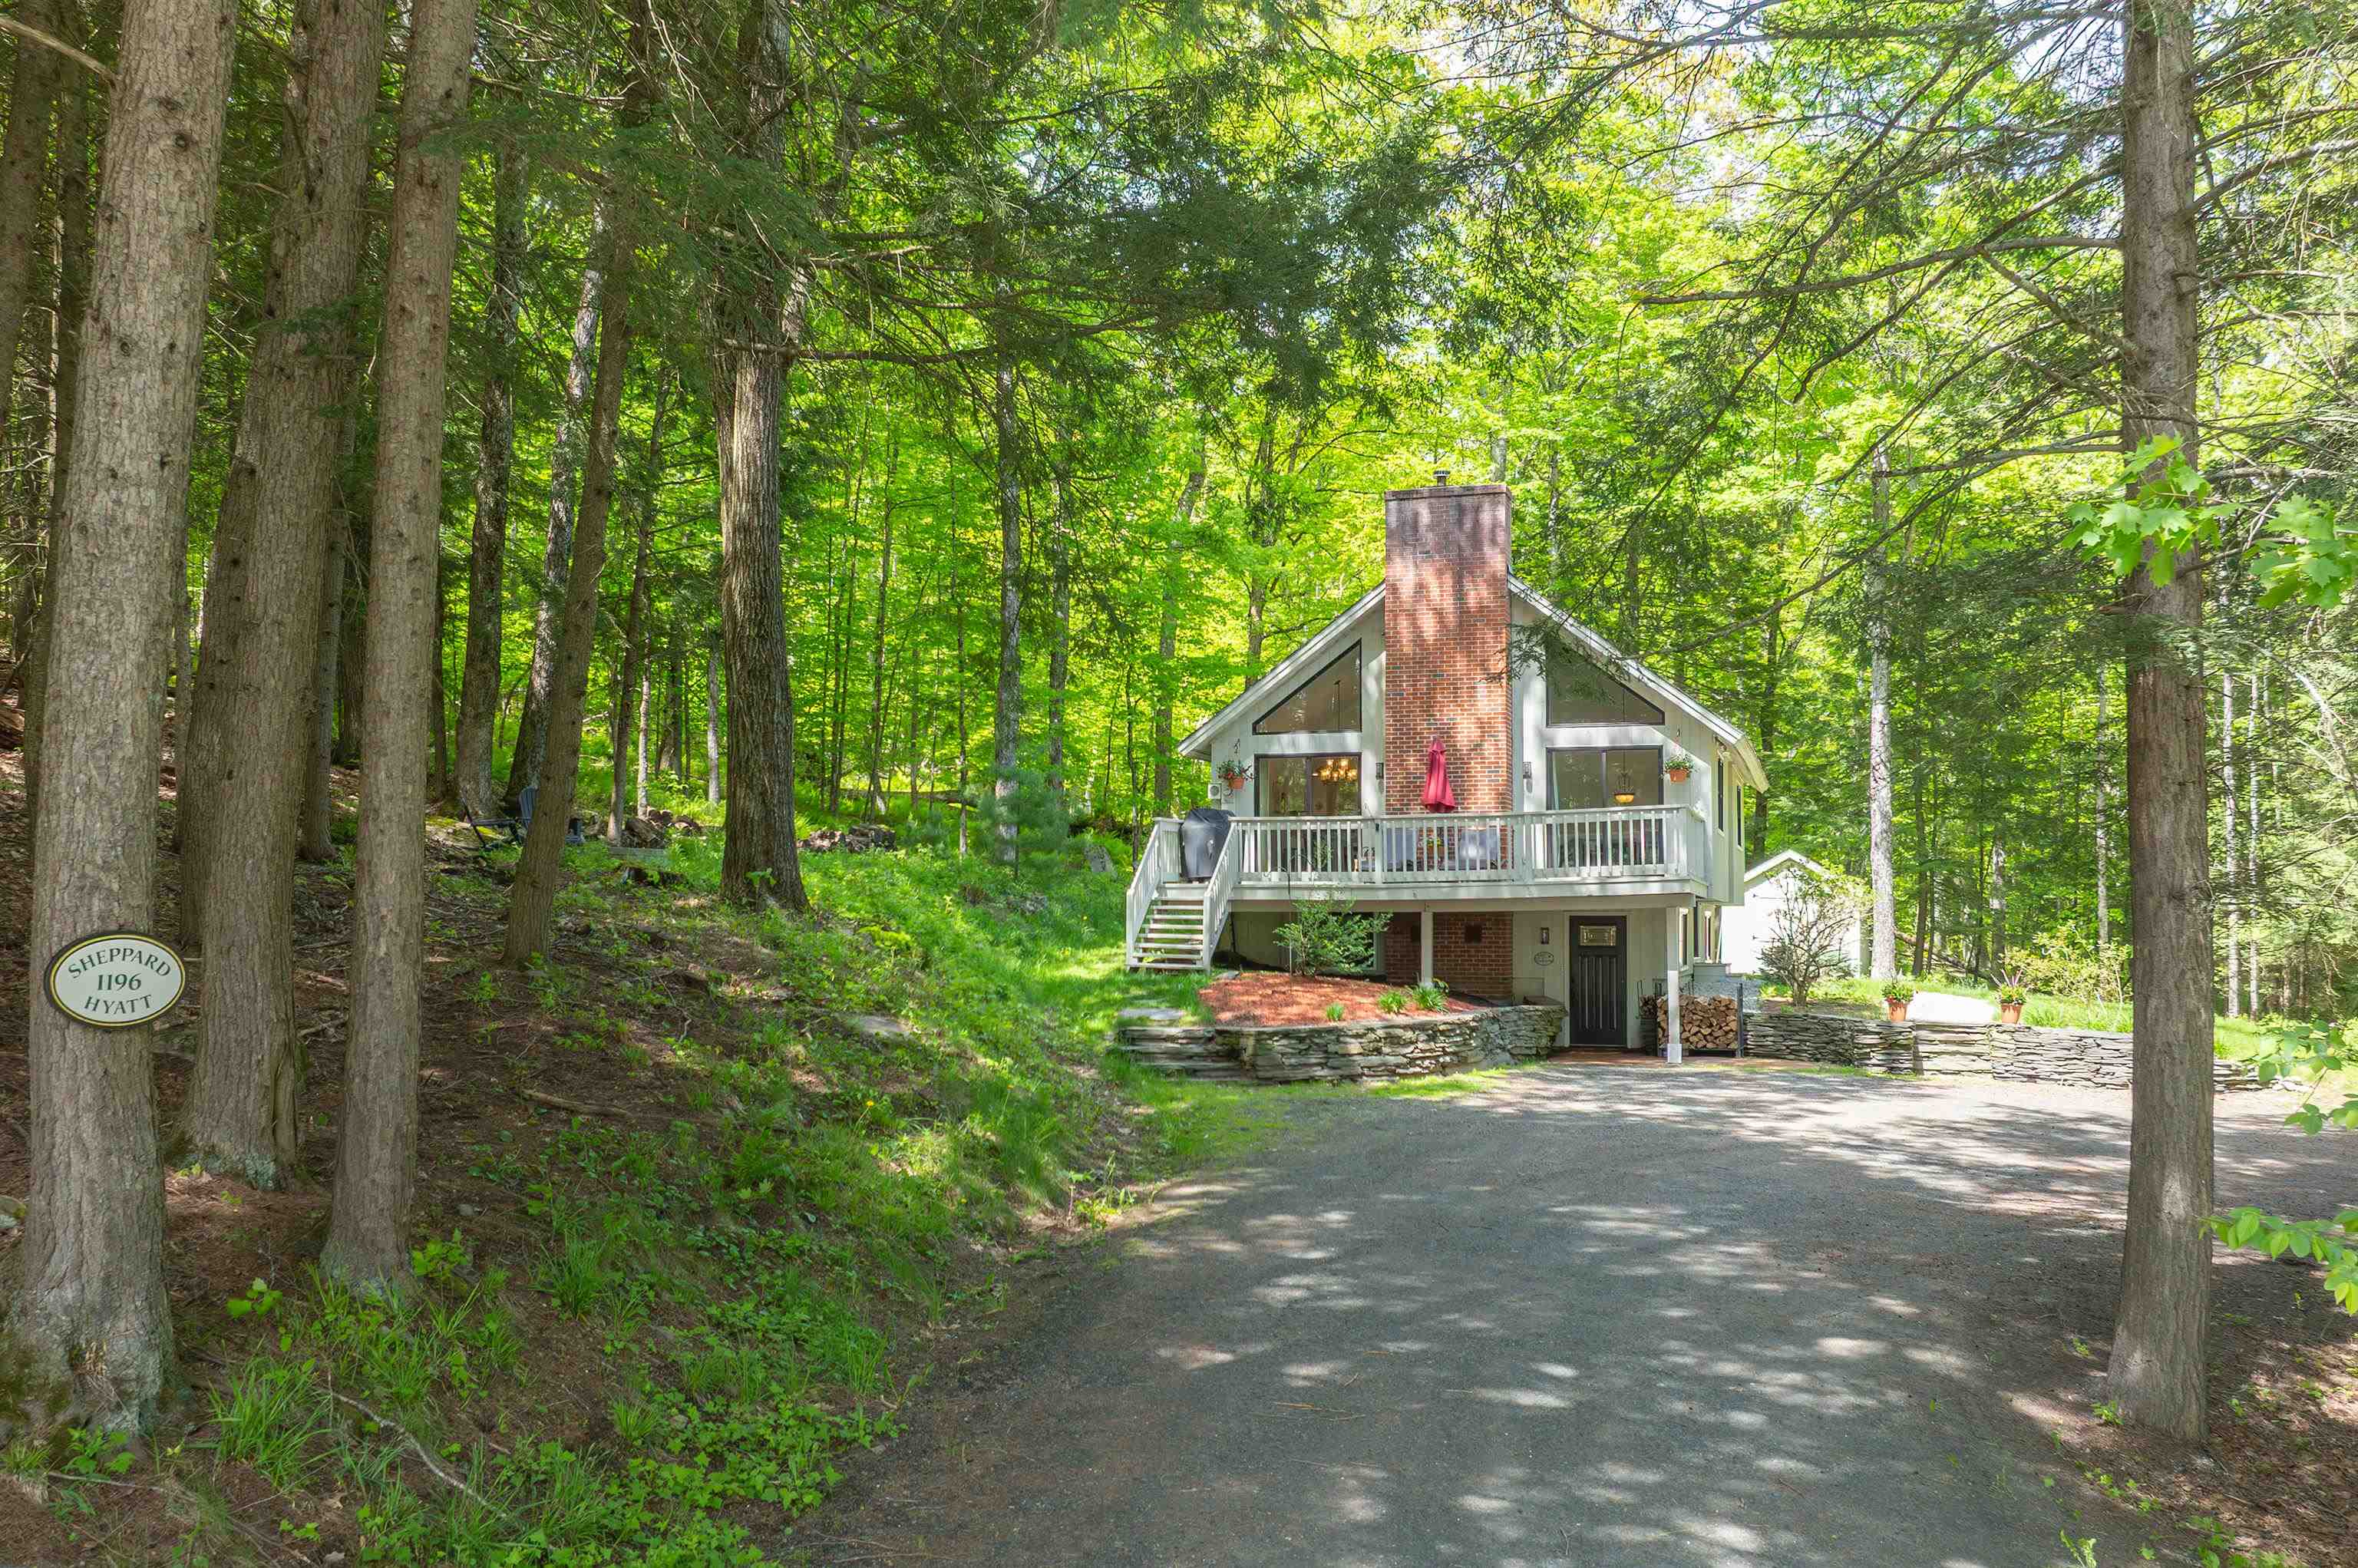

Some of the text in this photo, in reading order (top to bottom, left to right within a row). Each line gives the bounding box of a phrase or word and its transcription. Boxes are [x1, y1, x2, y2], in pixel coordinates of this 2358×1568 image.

[68, 948, 171, 979] SHEPPARD
[97, 973, 142, 991] 1196
[84, 995, 152, 1015] HYATT
